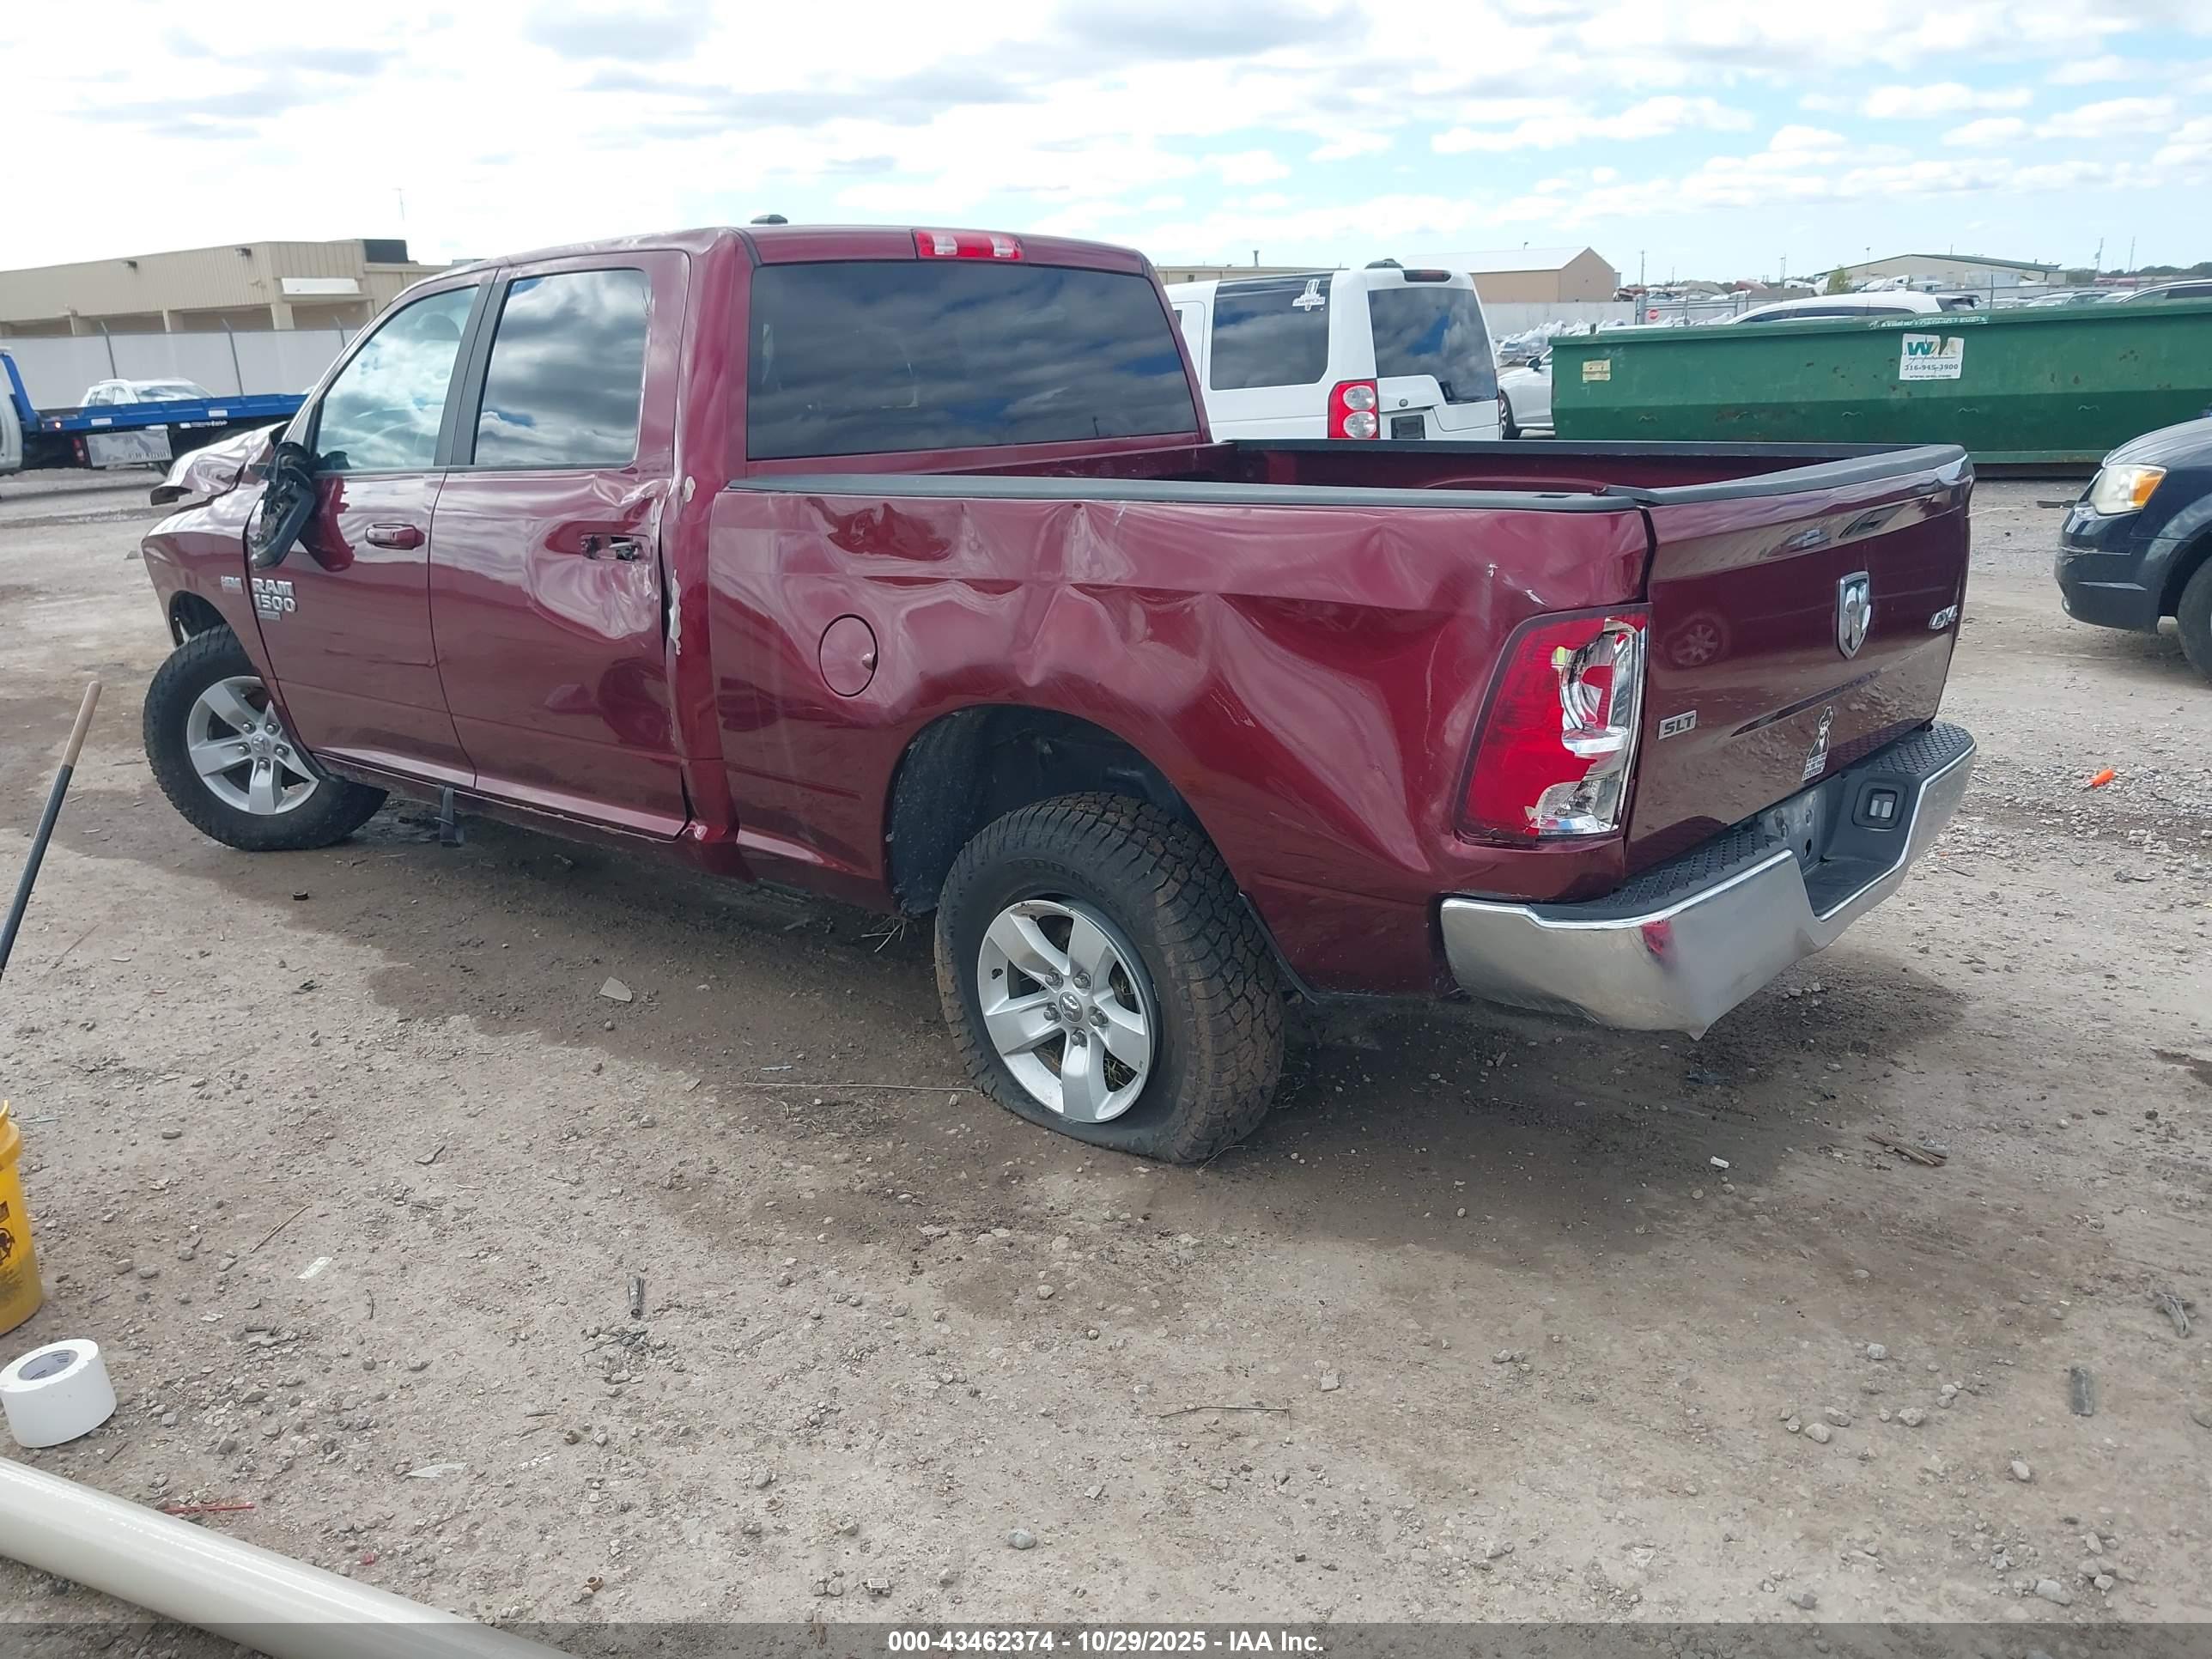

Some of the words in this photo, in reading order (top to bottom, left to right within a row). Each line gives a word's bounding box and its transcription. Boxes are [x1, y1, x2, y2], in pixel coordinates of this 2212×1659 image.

[252, 577, 294, 596] RAM
[254, 593, 296, 612] 1500
[1663, 714, 1695, 735] SLT
